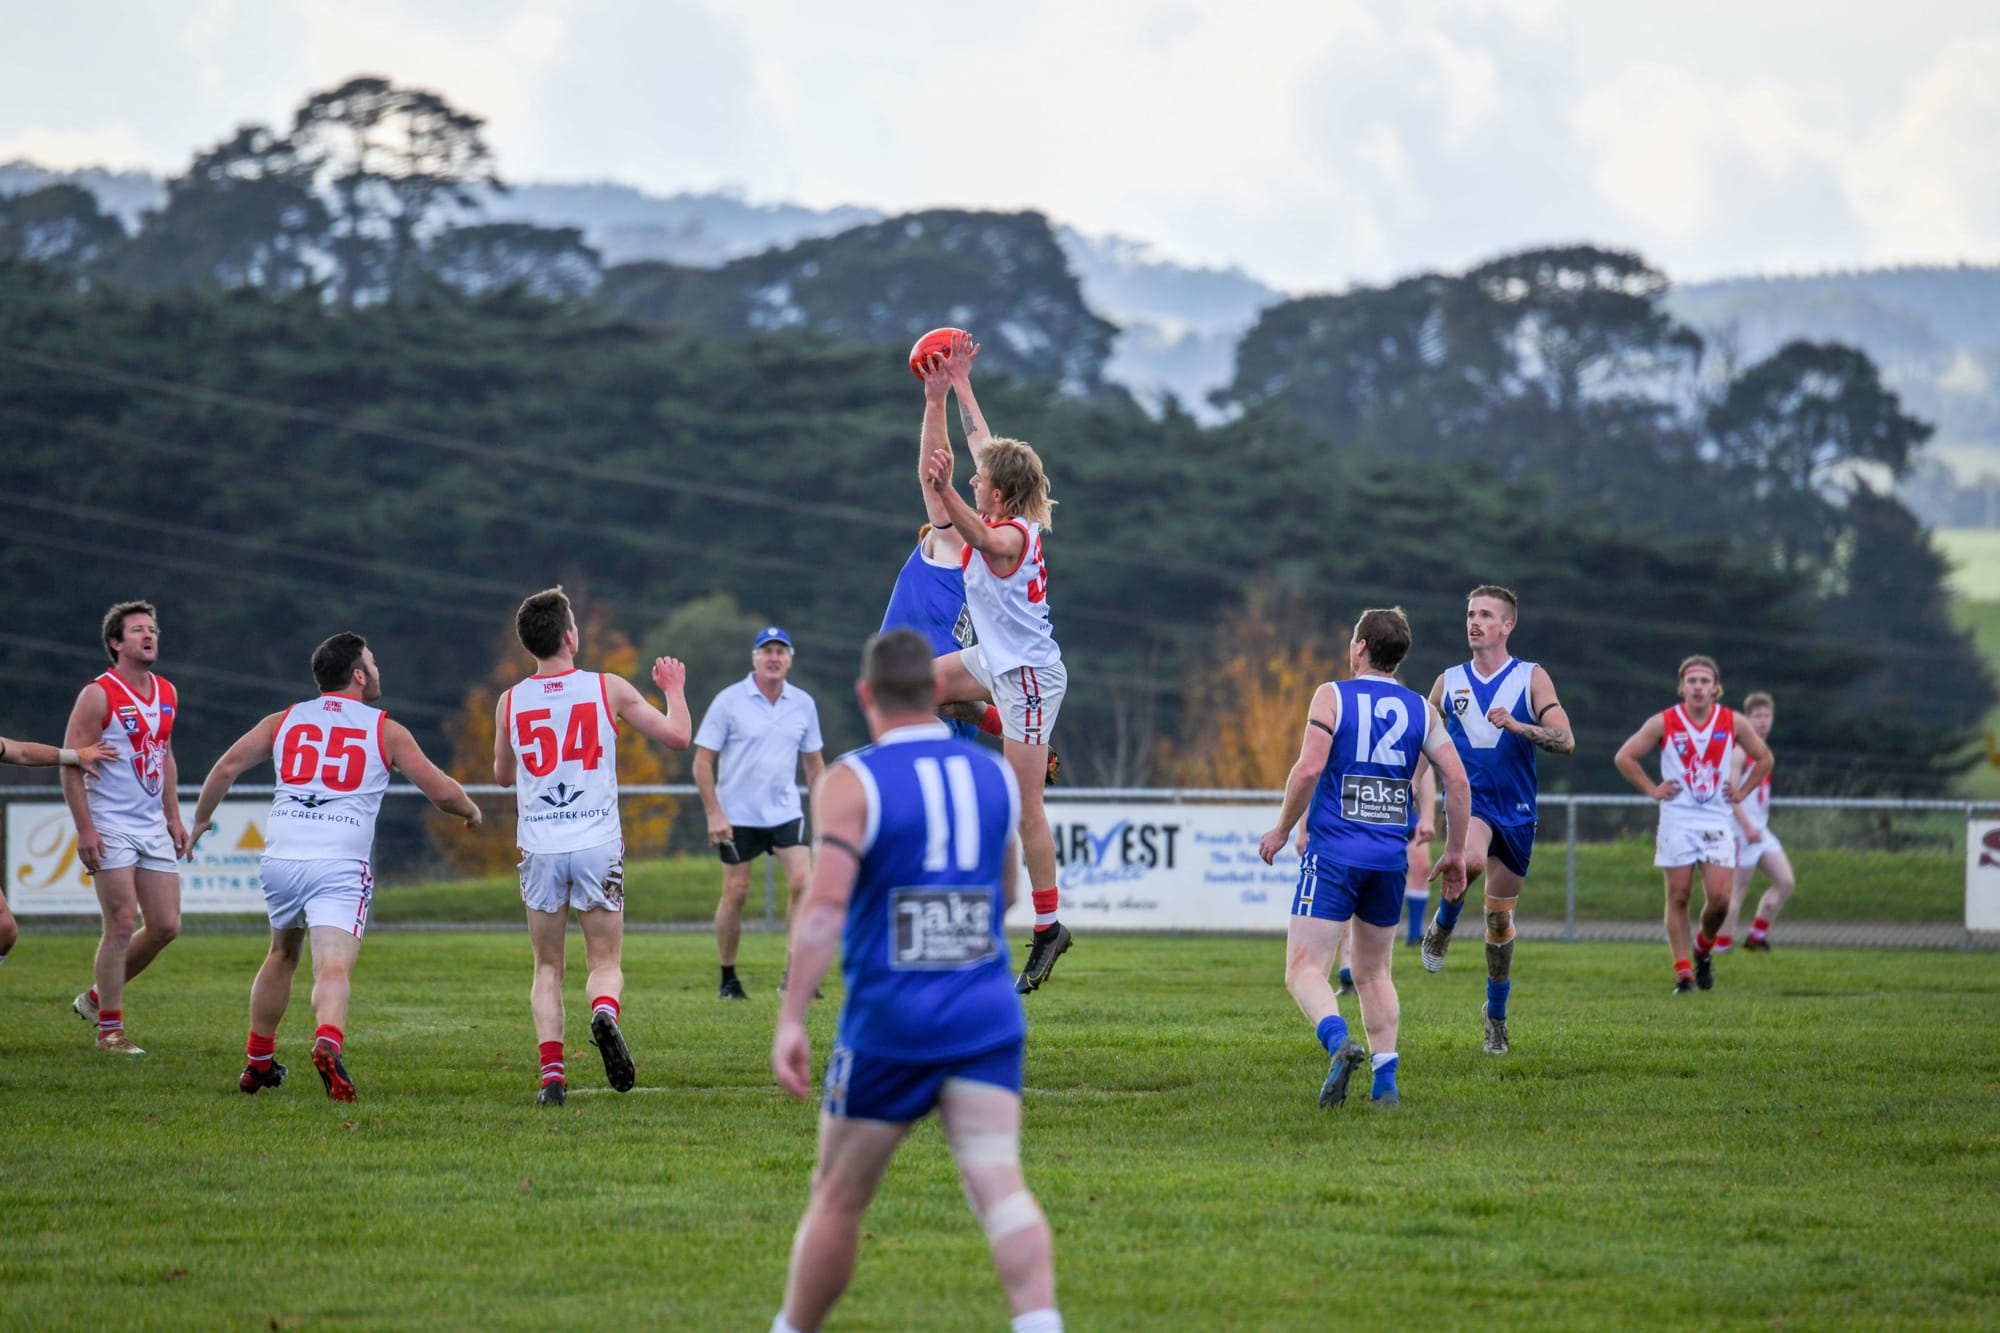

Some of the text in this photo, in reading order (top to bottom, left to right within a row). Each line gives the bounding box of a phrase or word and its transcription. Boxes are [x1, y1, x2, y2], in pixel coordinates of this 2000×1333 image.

[280, 723, 367, 792] 65
[516, 702, 603, 777] 54
[1356, 693, 1408, 767] 12
[291, 809, 324, 820] CREEK
[327, 814, 361, 827] HOTEL
[546, 810, 578, 820] CREEK
[914, 755, 981, 872] 11
[1052, 819, 1180, 869] ARVEST
